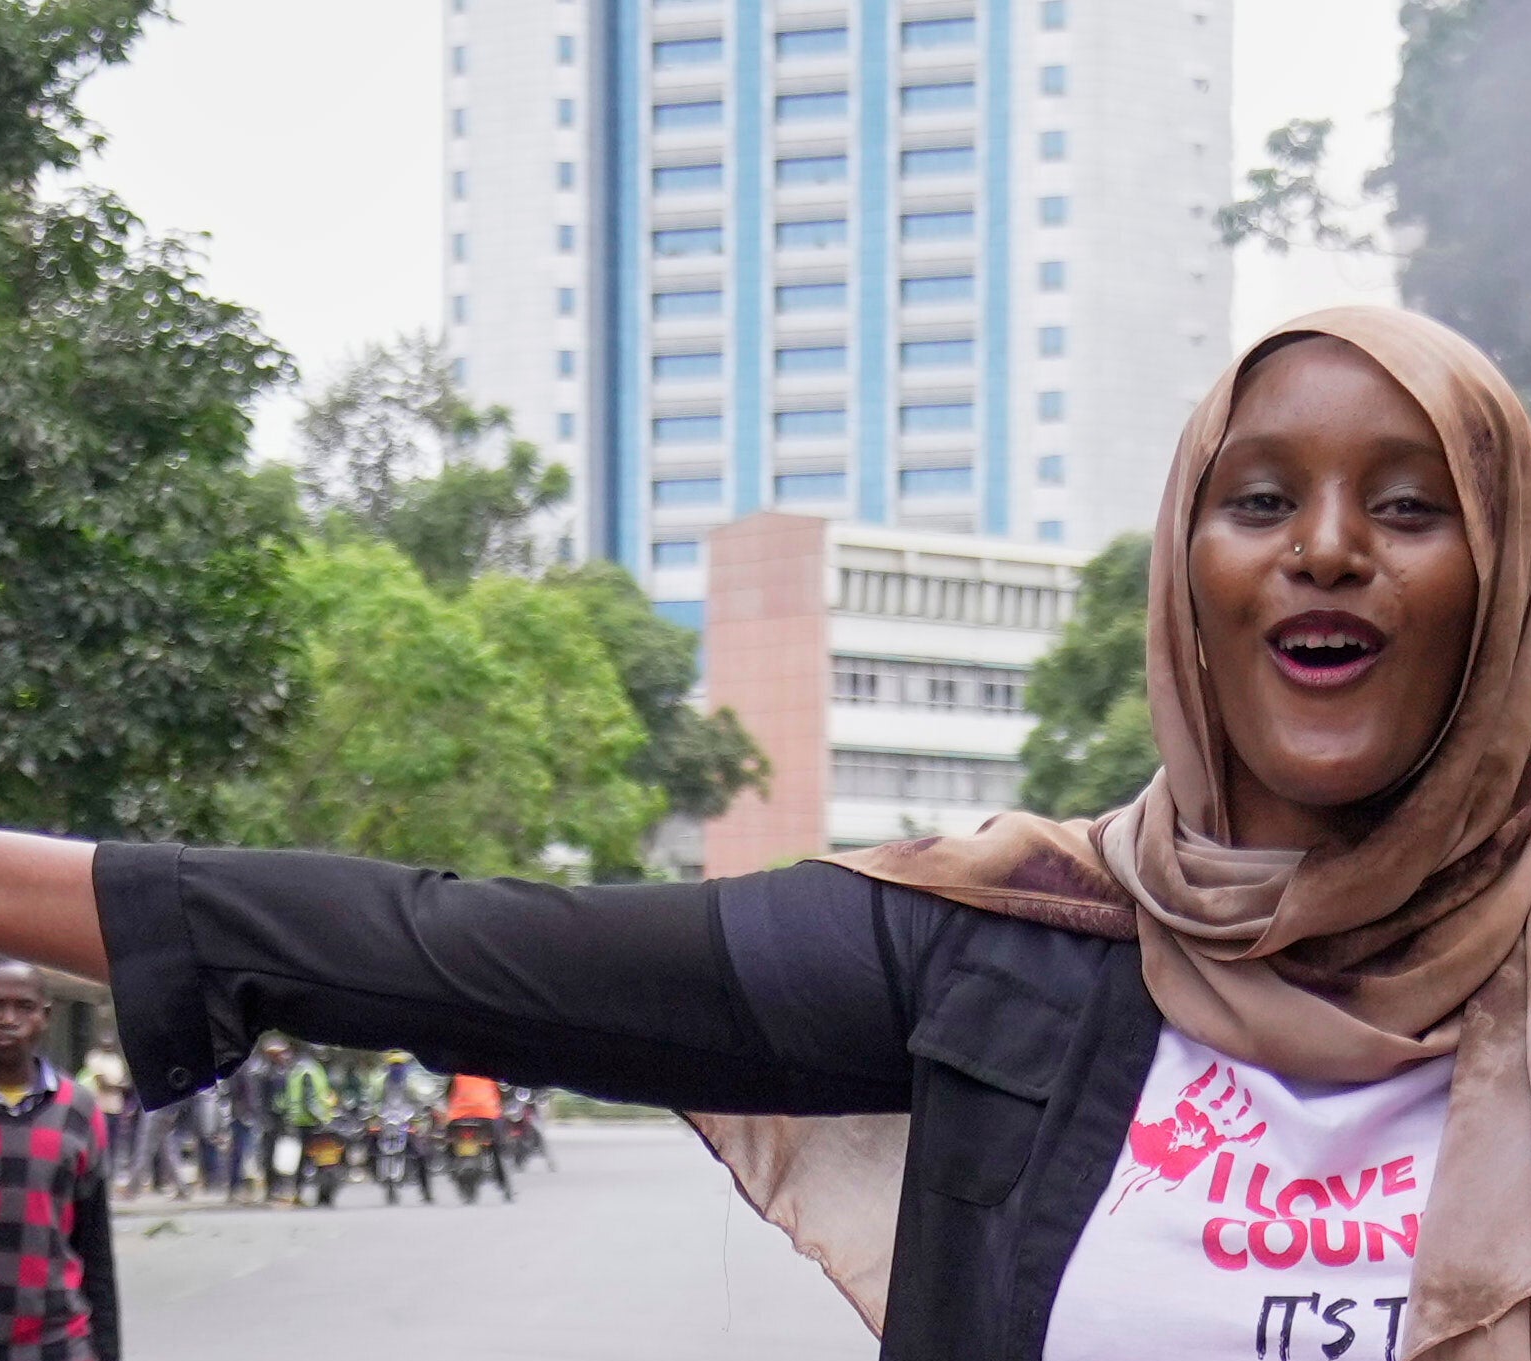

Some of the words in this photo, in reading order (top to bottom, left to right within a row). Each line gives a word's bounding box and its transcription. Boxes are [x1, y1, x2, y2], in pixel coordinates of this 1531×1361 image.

[1207, 1151, 1235, 1204] I
[1246, 1155, 1416, 1219] LOVE
[1202, 1213, 1426, 1271] COUN
